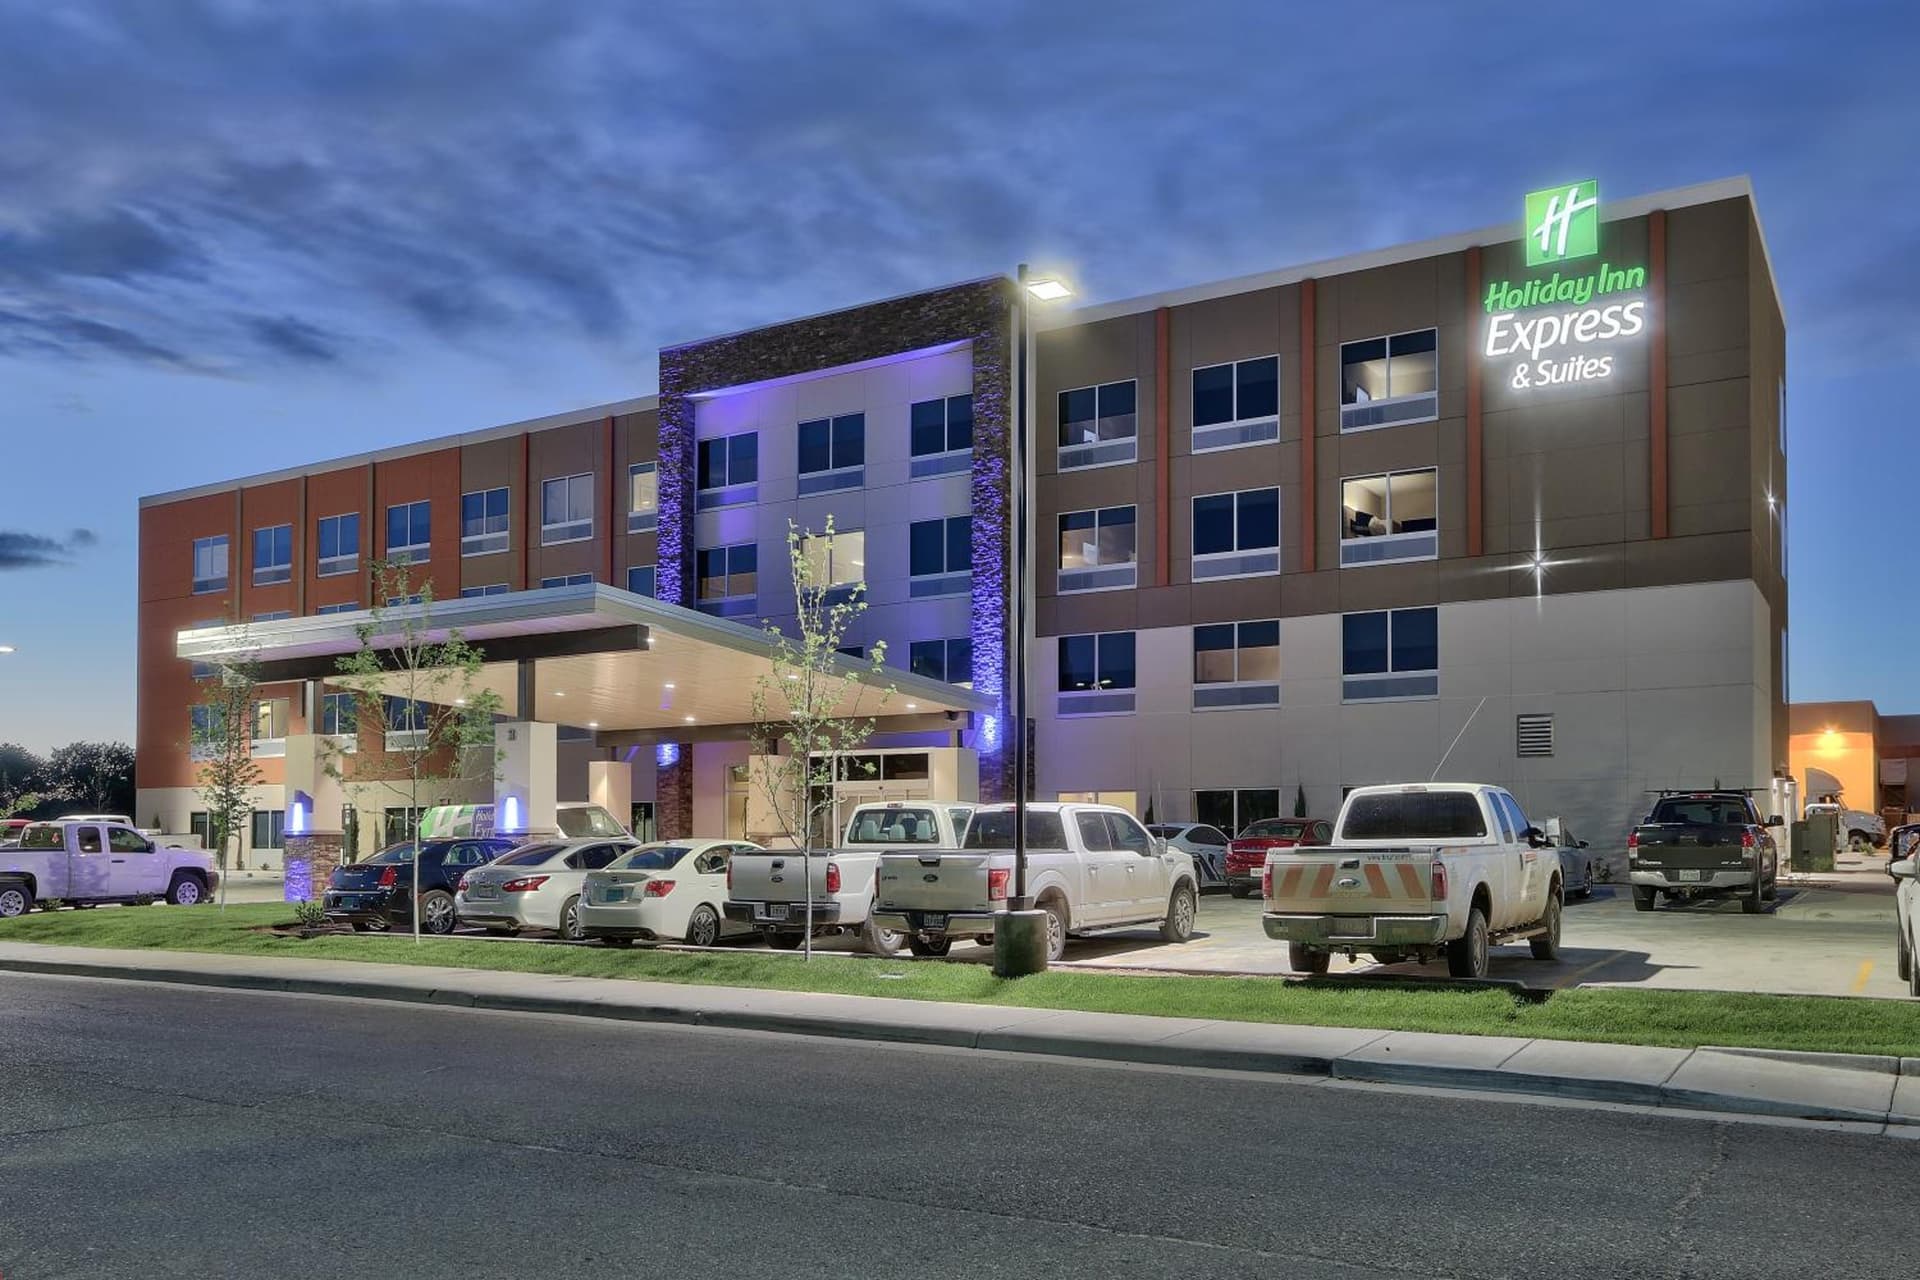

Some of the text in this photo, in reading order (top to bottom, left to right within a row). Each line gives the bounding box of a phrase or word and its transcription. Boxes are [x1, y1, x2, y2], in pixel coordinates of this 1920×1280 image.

[1484, 263, 1645, 312] Holiday Inn
[1486, 302, 1645, 360] Express
[1511, 355, 1613, 389] & Suites
